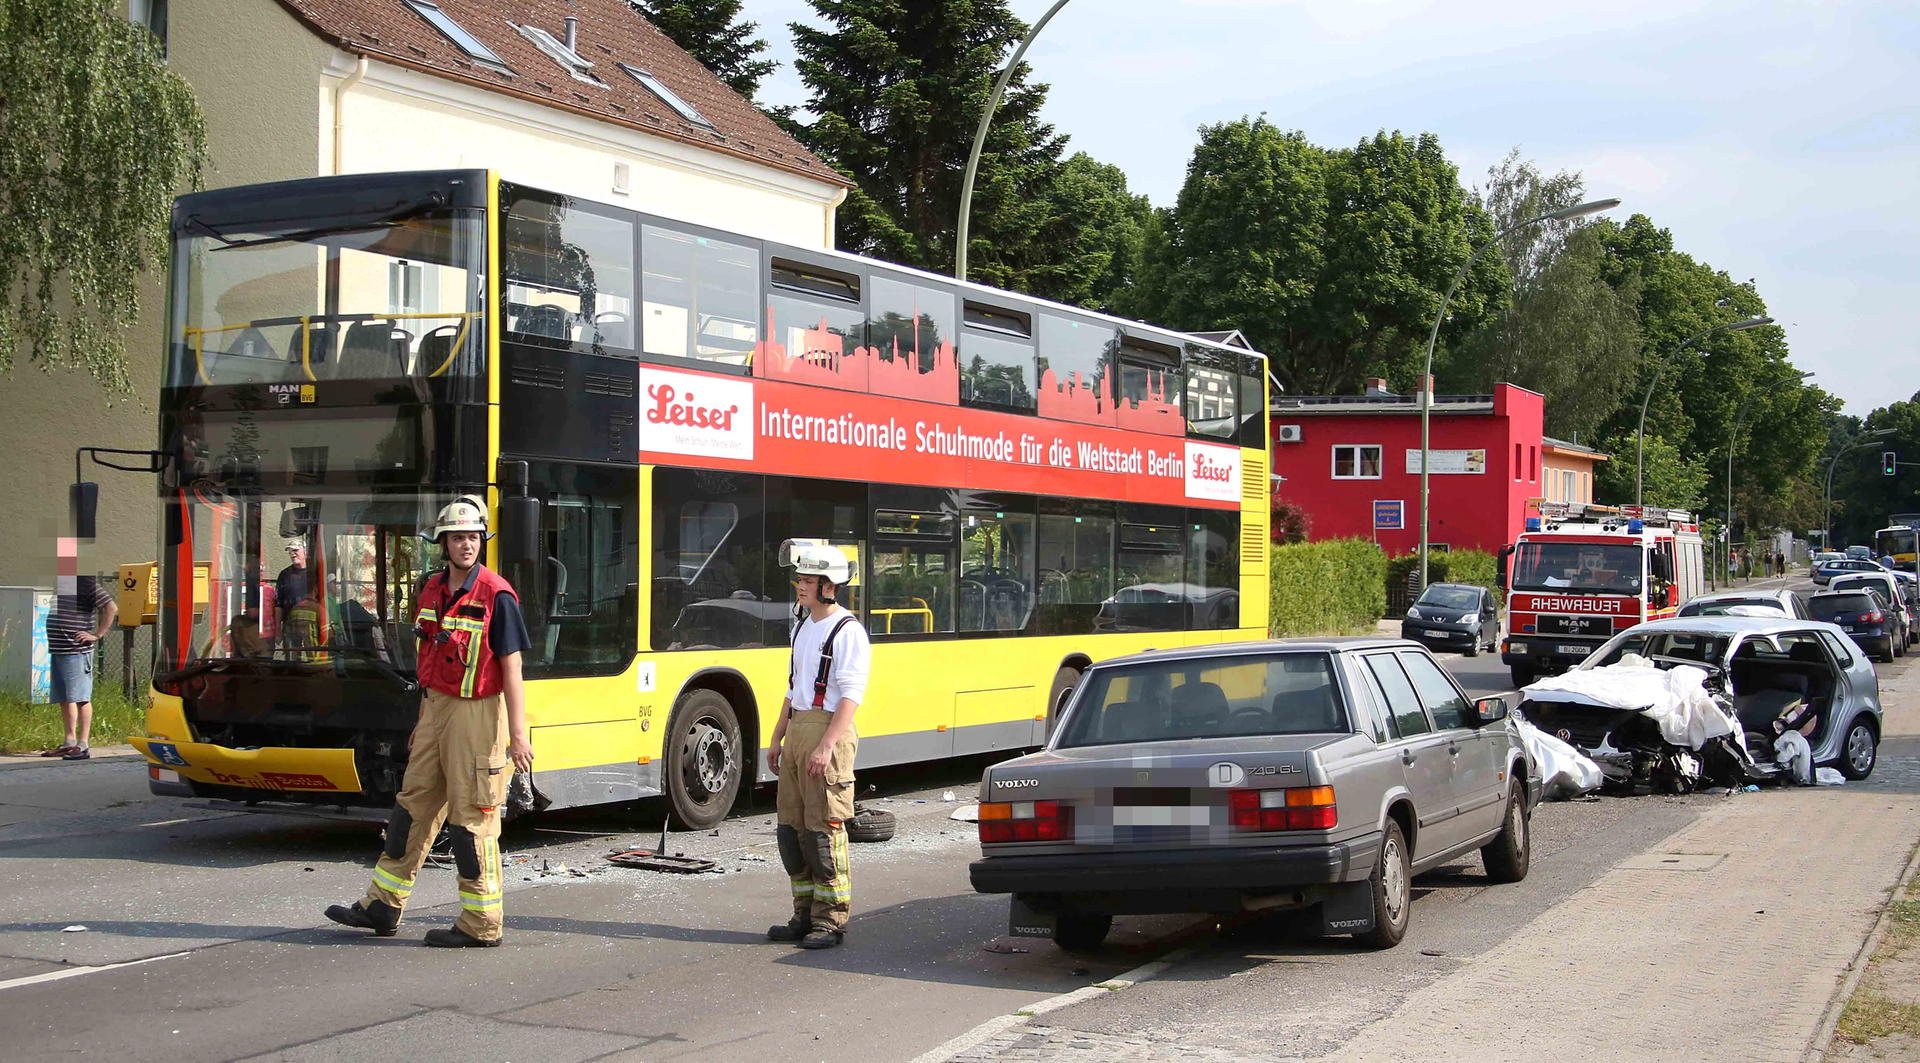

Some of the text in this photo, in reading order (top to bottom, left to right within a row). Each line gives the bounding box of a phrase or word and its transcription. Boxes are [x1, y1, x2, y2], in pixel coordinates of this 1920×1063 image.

[268, 384, 299, 393] MAN
[646, 384, 738, 431] Leiser
[761, 402, 1184, 478] Internationale Schuhmode für die Weltstadt Berlin
[1192, 453, 1232, 482] Leiser
[1559, 619, 1590, 628] MAN
[638, 705, 653, 718] BVG
[1218, 763, 1233, 783] D
[1247, 765, 1301, 775] 740 GL
[994, 779, 1039, 789] VOLVO
[1329, 919, 1368, 928] VOLVO
[1015, 926, 1052, 934] VOLVO
